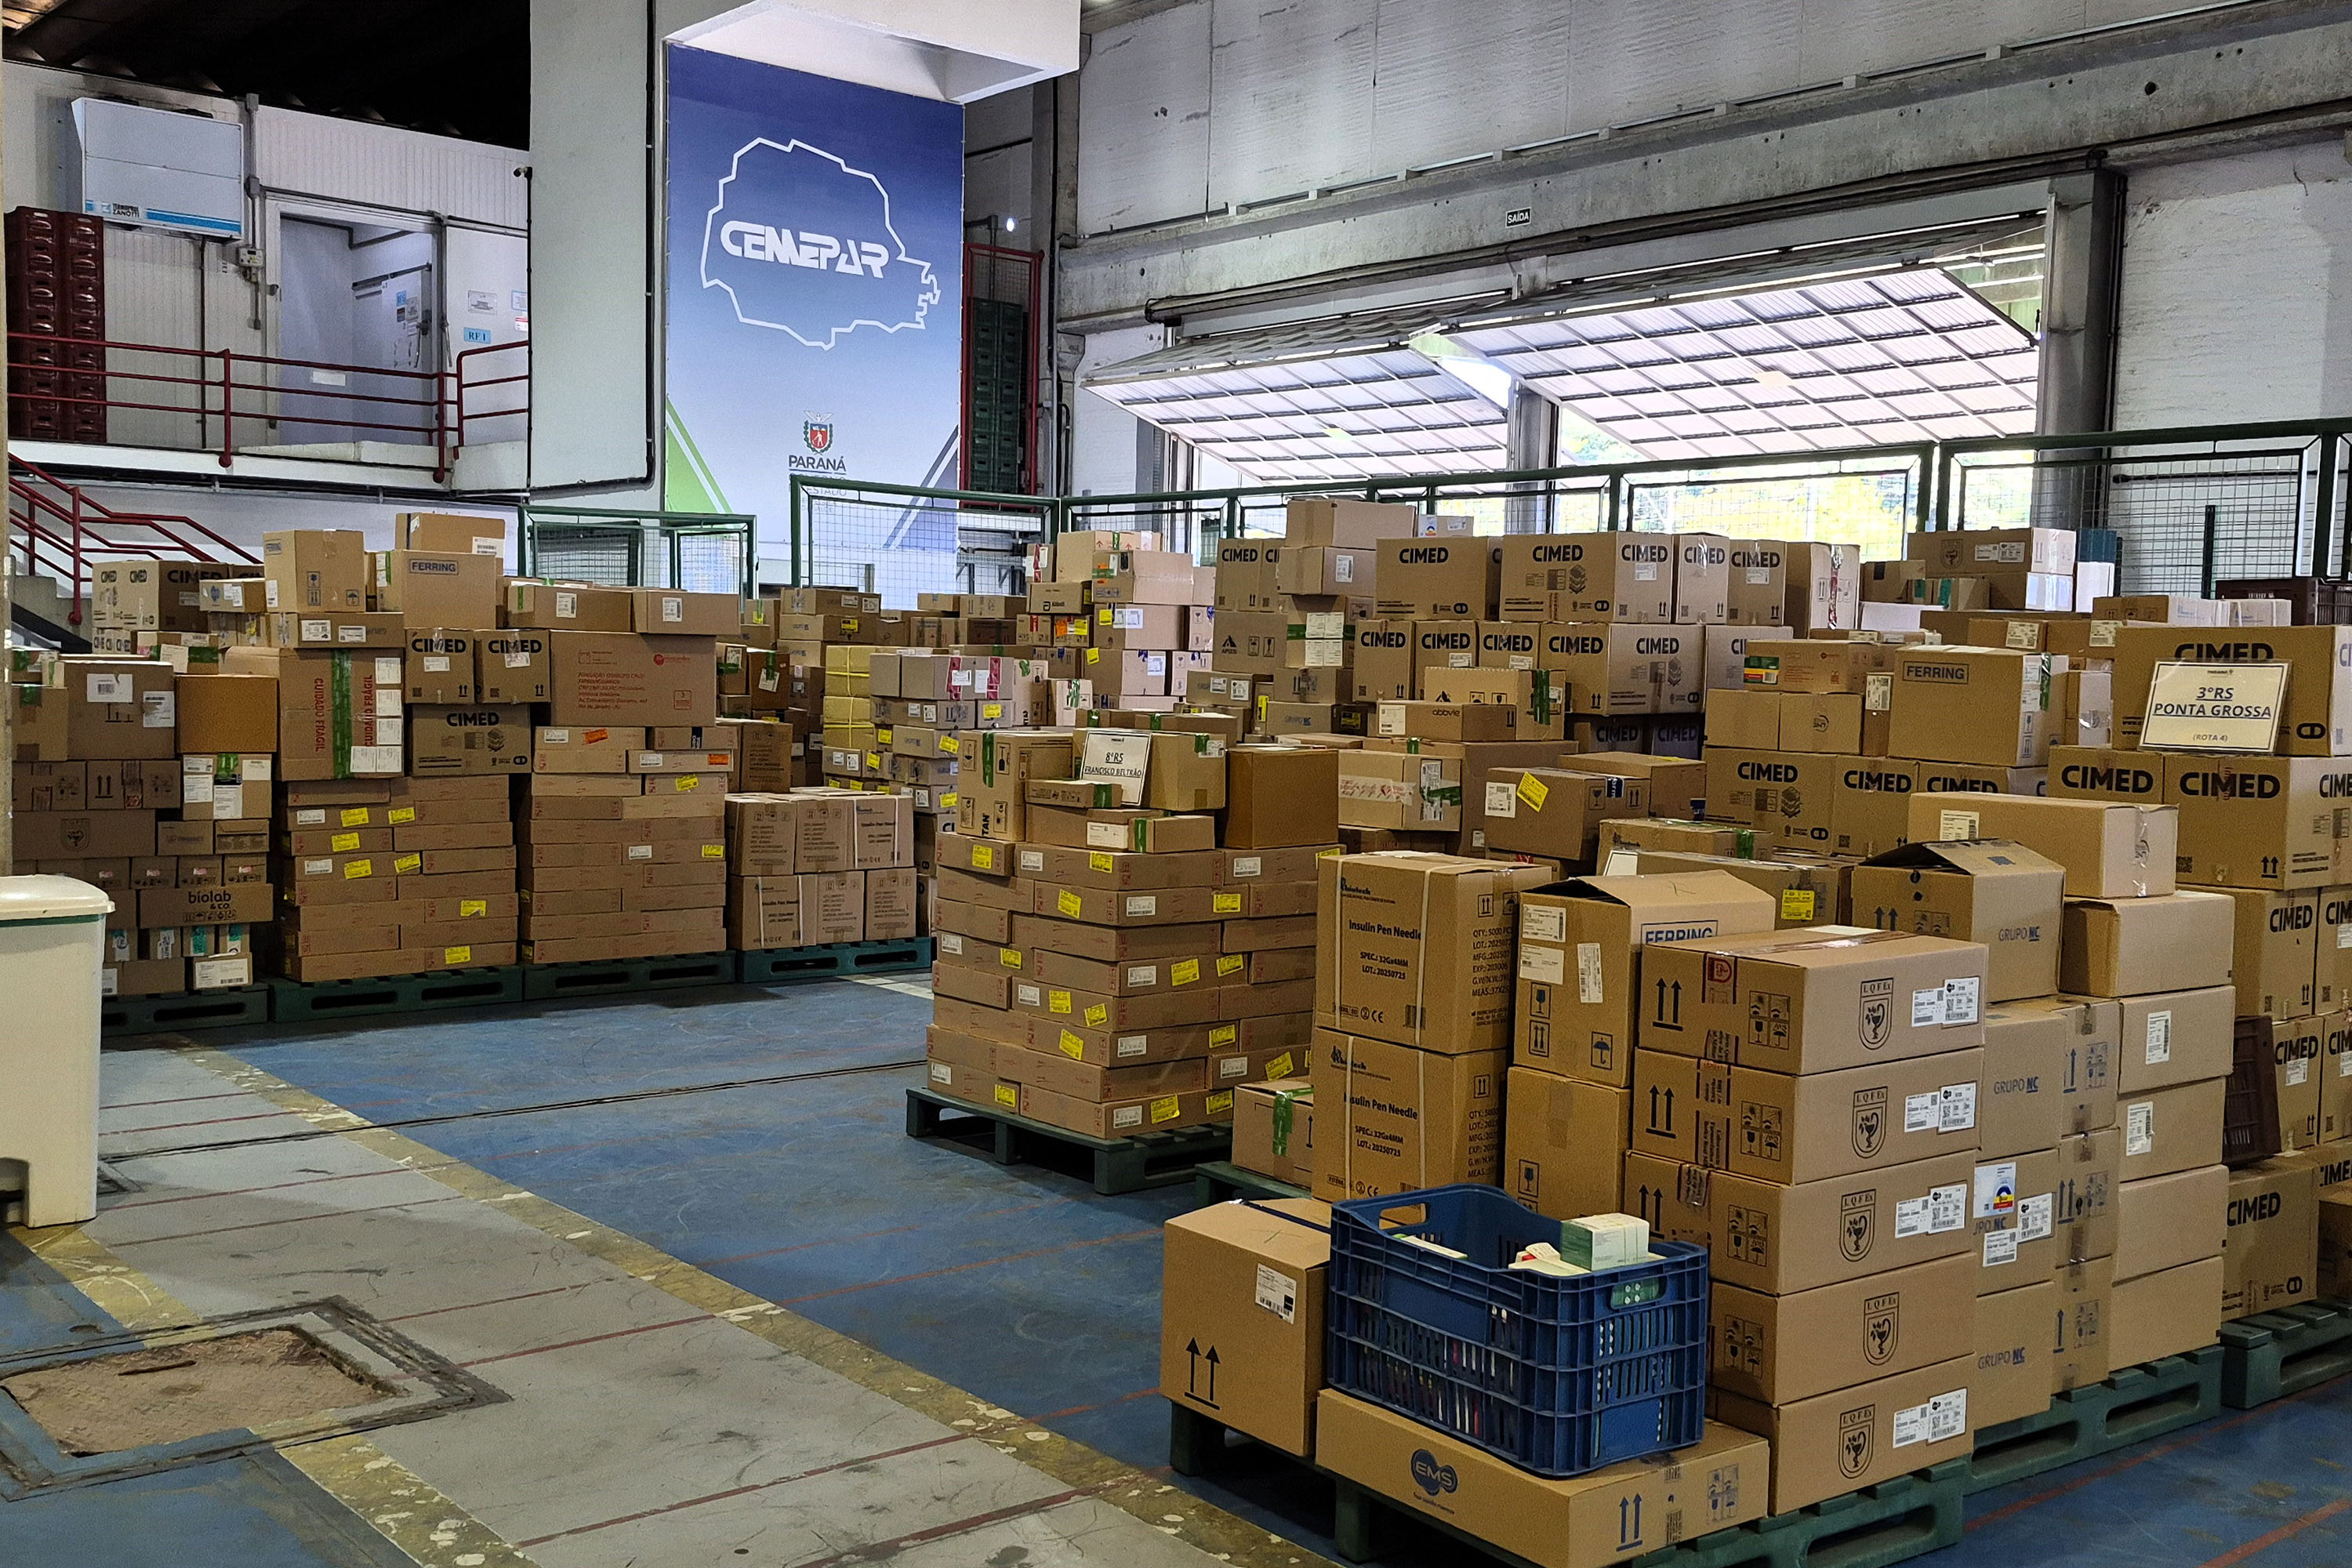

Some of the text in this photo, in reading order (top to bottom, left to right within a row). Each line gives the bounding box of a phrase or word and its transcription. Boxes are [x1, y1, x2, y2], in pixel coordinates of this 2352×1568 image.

[1508, 211, 1529, 223] SAÍDA
[720, 220, 889, 278] CEMEPAR
[468, 330, 481, 339] RF
[789, 455, 847, 472] PARANÁ
[1221, 549, 1258, 562] CIMED
[1399, 547, 1449, 564] CIMED
[1533, 545, 1583, 562] CIMED
[1621, 544, 1668, 562] CIMED
[1731, 551, 1780, 568] CIMED
[412, 562, 456, 572] FERRING
[1360, 632, 1406, 648] CIMED
[1421, 633, 1471, 649] CIMED
[1483, 634, 1534, 652] CIMED
[1548, 636, 1603, 654] CIMED
[1636, 637, 1679, 654] CIMED
[1907, 666, 1965, 679] FERRING
[1432, 708, 1461, 717] abbvie
[2154, 703, 2271, 717] PONTA GROSSA
[446, 712, 499, 726] CIMED
[1596, 726, 1639, 742] CIMED
[2193, 733, 2217, 742] (ROTA
[1084, 766, 1142, 776] FRANCISCO BELTRÃO
[1737, 762, 1798, 782] CIMED
[2061, 765, 2154, 793] CIMED
[1844, 770, 1912, 793] CIMED
[2180, 771, 2281, 800] CIMED
[2319, 773, 2352, 797] CIME
[188, 891, 231, 903] biolab
[2270, 905, 2313, 932] CIMED
[2325, 901, 2352, 925] CIM
[1349, 920, 1421, 941] Insulin Pen Needle
[1998, 926, 2040, 941] GRUPO NC
[1377, 967, 1406, 980] 20250725
[2275, 1036, 2318, 1065] CIMED
[2328, 1030, 2352, 1055] CIM
[1994, 1076, 2038, 1094] GRUPO NC
[1344, 1091, 1418, 1120] Isulin Pen Needle
[1372, 1142, 1401, 1156] 20250725
[2319, 1160, 2352, 1187] IME
[2227, 1192, 2281, 1227] CIMED
[1978, 1348, 2025, 1370] GRUPO NC
[1415, 1461, 1453, 1486] EMS
